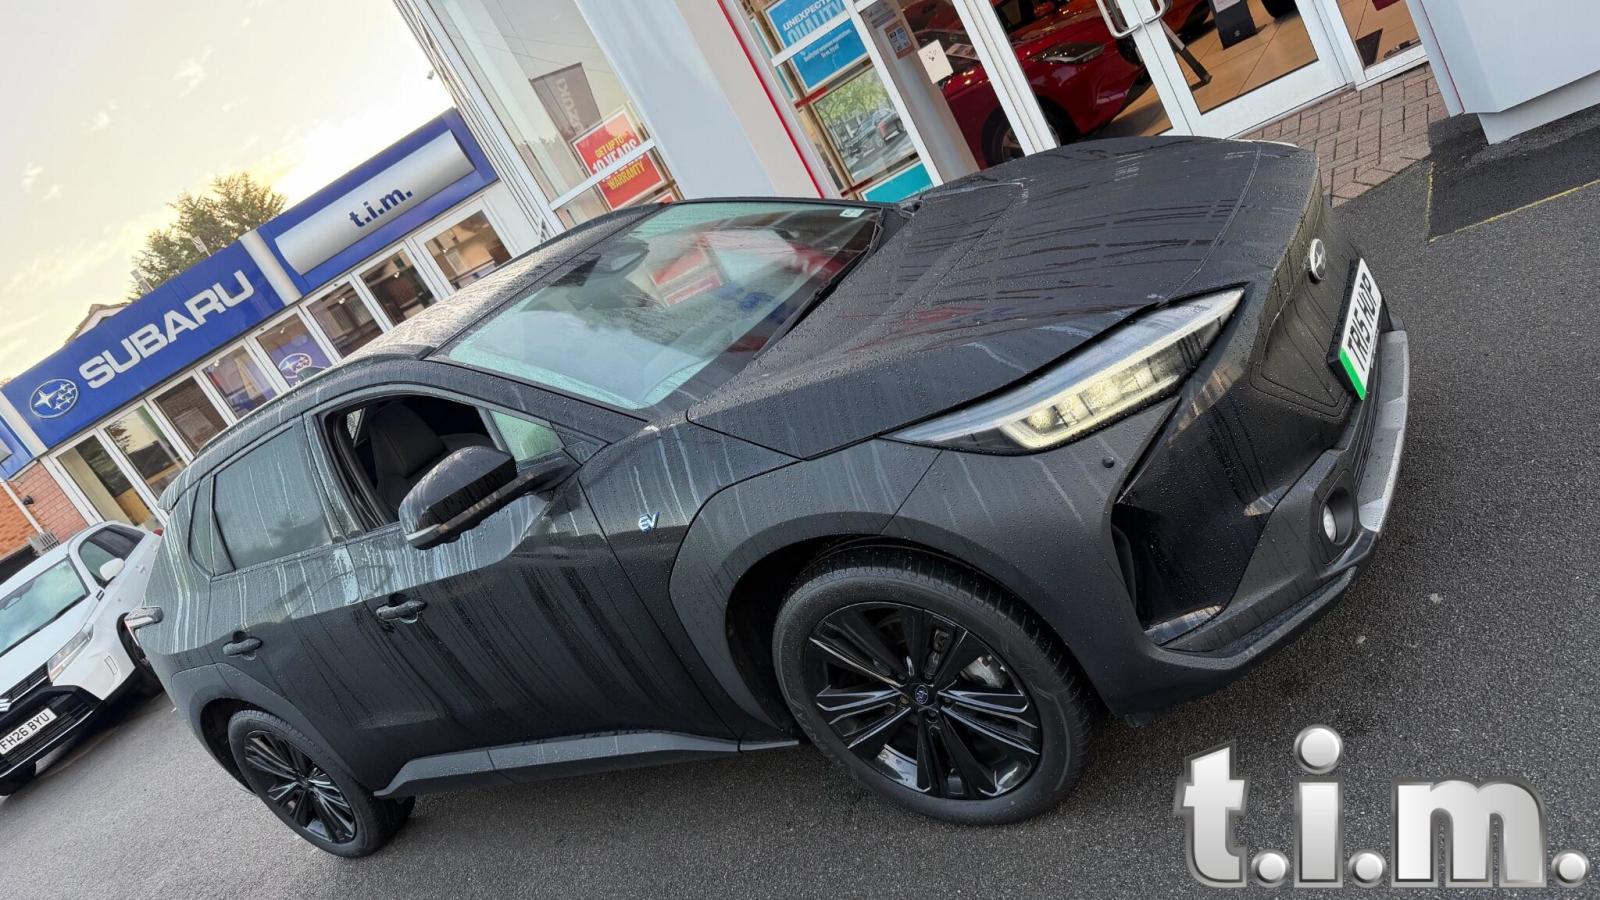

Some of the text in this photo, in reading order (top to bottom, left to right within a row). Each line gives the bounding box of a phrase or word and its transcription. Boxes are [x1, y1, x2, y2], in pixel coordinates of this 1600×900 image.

[556, 78, 584, 133] UZUKI
[594, 135, 624, 158] GET UP TO
[607, 160, 645, 190] WARRANTY
[349, 189, 413, 227] t.i.m.
[78, 270, 254, 389] SUBARU
[0, 712, 50, 750] FH26 BYU
